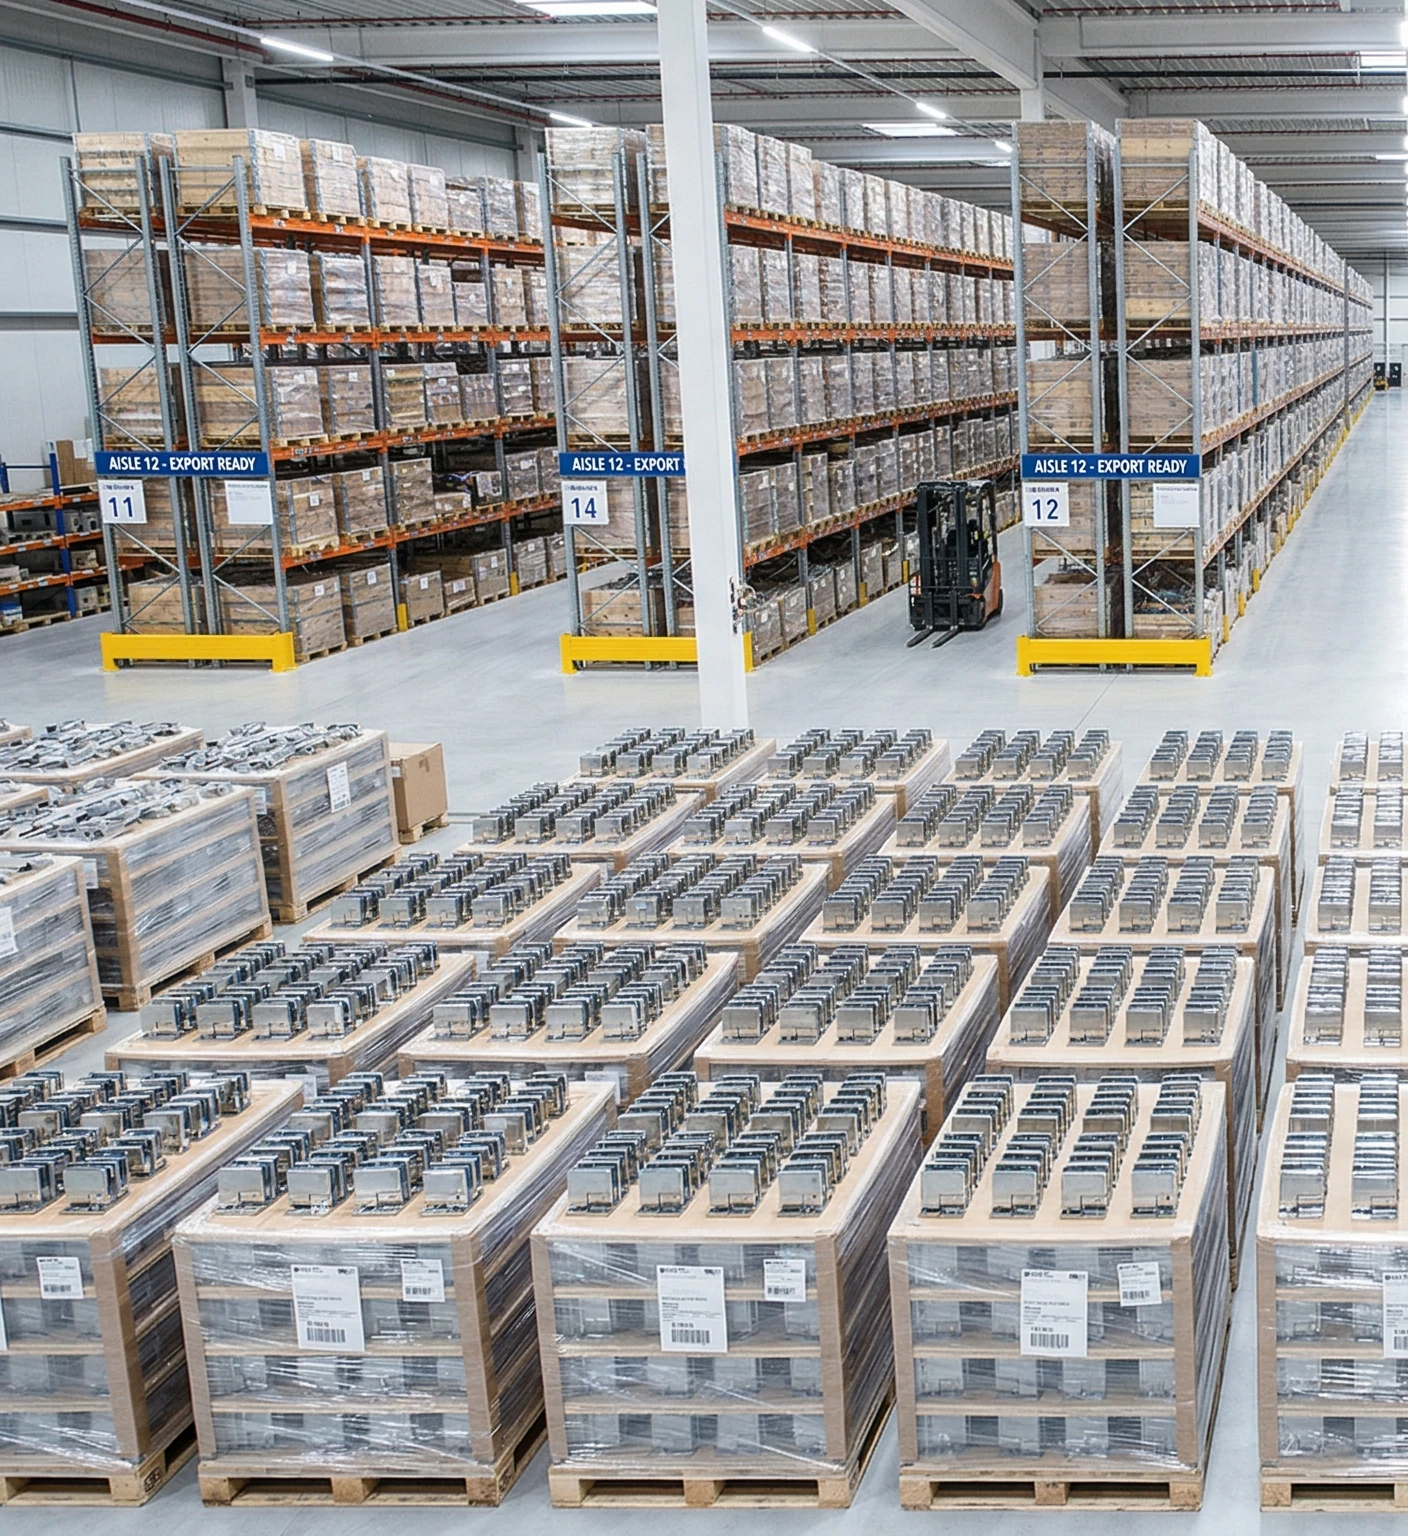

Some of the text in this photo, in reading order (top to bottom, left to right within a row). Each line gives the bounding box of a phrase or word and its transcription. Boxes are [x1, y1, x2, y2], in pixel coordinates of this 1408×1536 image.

[109, 456, 142, 471] AISLE
[143, 456, 160, 471] 12
[169, 456, 215, 471] EXPORT
[217, 456, 256, 471] READY
[572, 457, 606, 471] AISLE
[608, 457, 624, 471] 12
[634, 457, 681, 471] EXPORT
[1034, 459, 1068, 474] AISLE
[1070, 459, 1087, 474] 12
[1097, 459, 1146, 474] EXPORT
[1147, 459, 1188, 474] READY
[108, 497, 133, 518] 11
[570, 497, 597, 519] 14
[1032, 499, 1059, 520] 12
